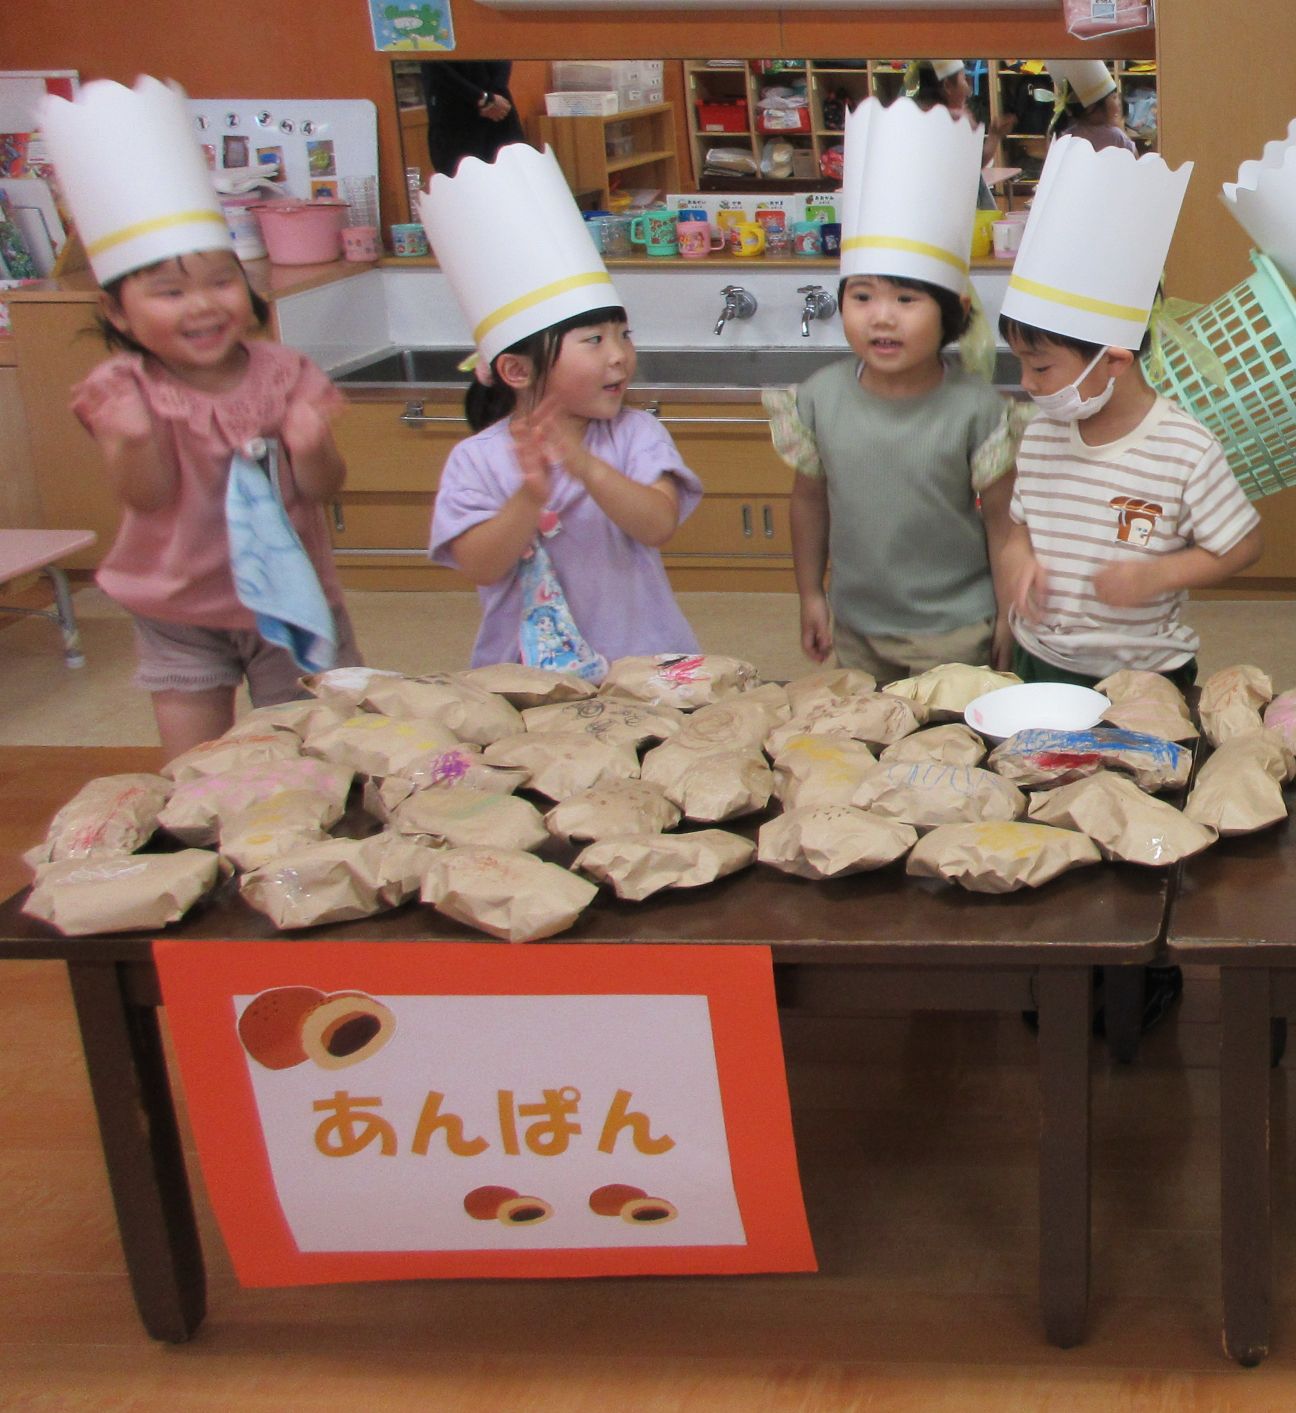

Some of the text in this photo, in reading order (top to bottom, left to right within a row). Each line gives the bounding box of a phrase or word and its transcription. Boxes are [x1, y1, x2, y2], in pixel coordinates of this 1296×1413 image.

[229, 115, 237, 127] 2
[260, 113, 270, 125] 3
[303, 122, 313, 134] 4
[312, 1087, 676, 1157] あんぱん
